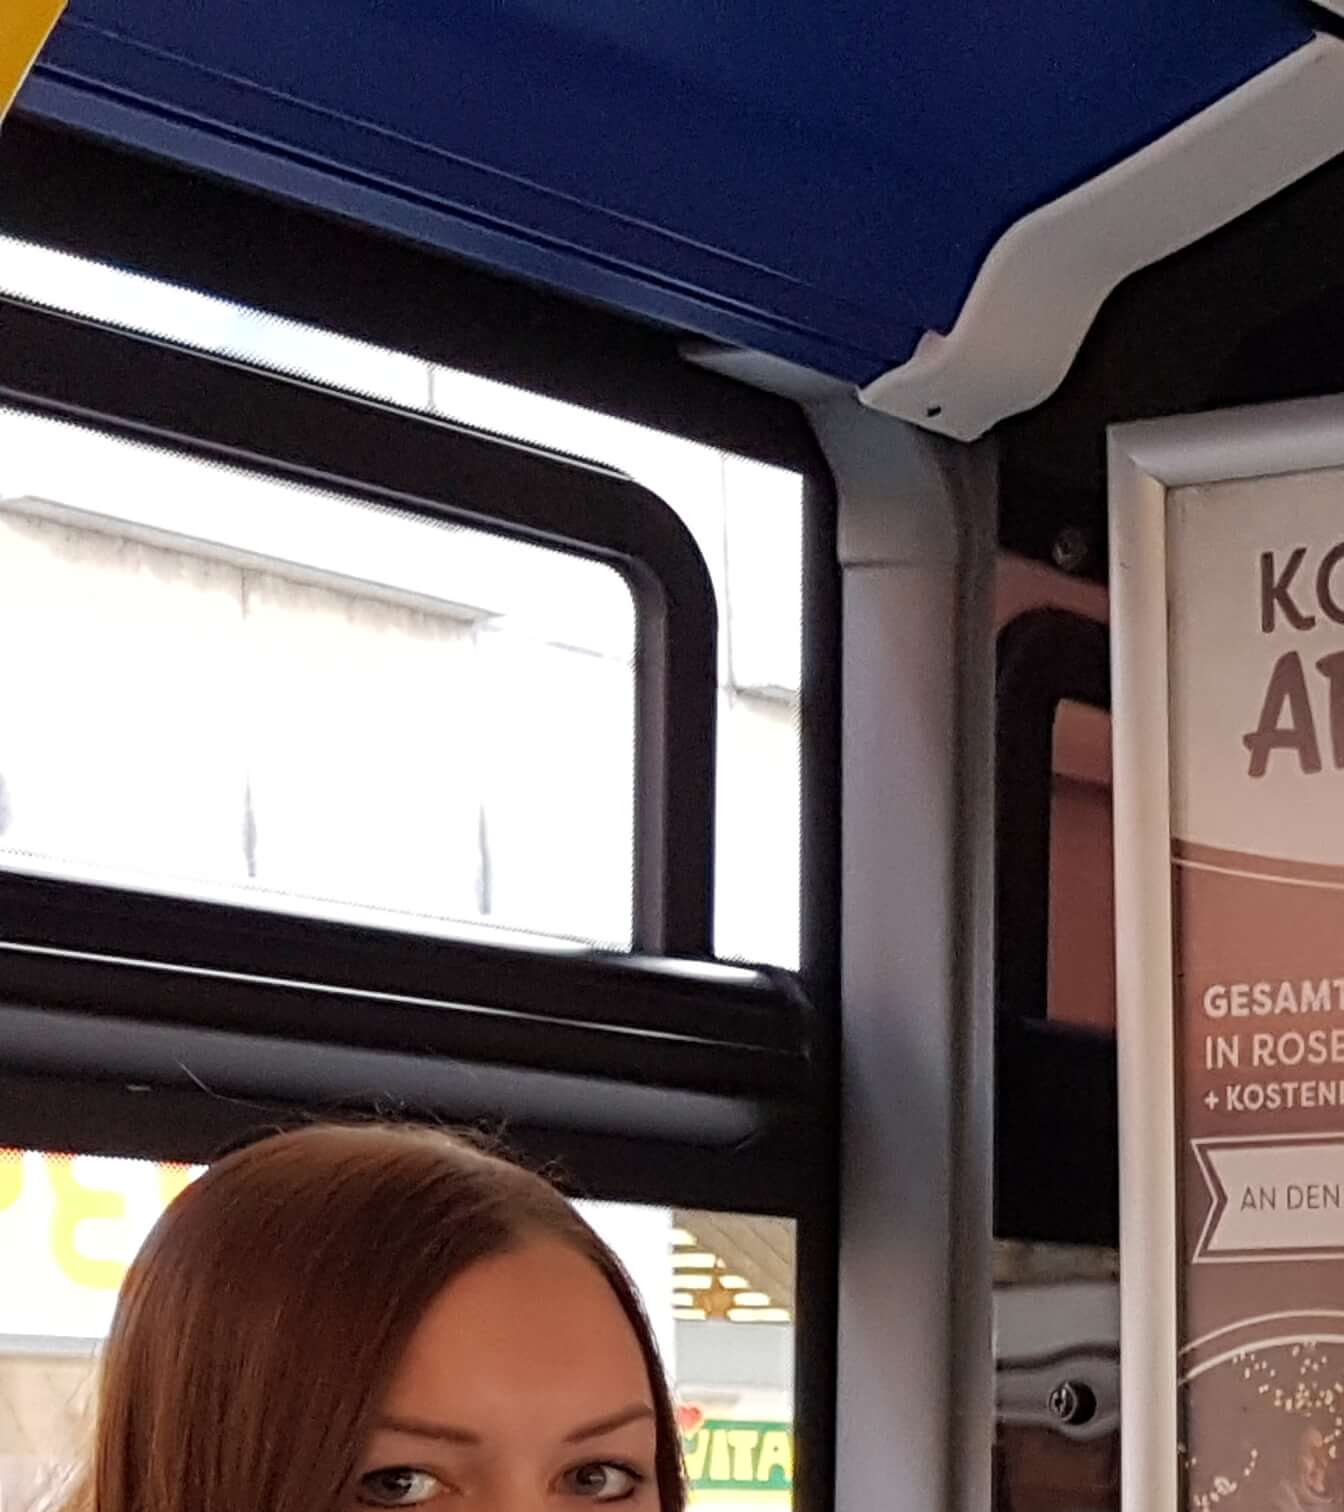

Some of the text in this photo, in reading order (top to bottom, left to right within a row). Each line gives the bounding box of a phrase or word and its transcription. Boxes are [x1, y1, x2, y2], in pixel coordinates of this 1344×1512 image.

[1206, 1037, 1239, 1070] IN
[1240, 1185, 1277, 1211] AN
[1286, 1182, 1341, 1209] DEN
